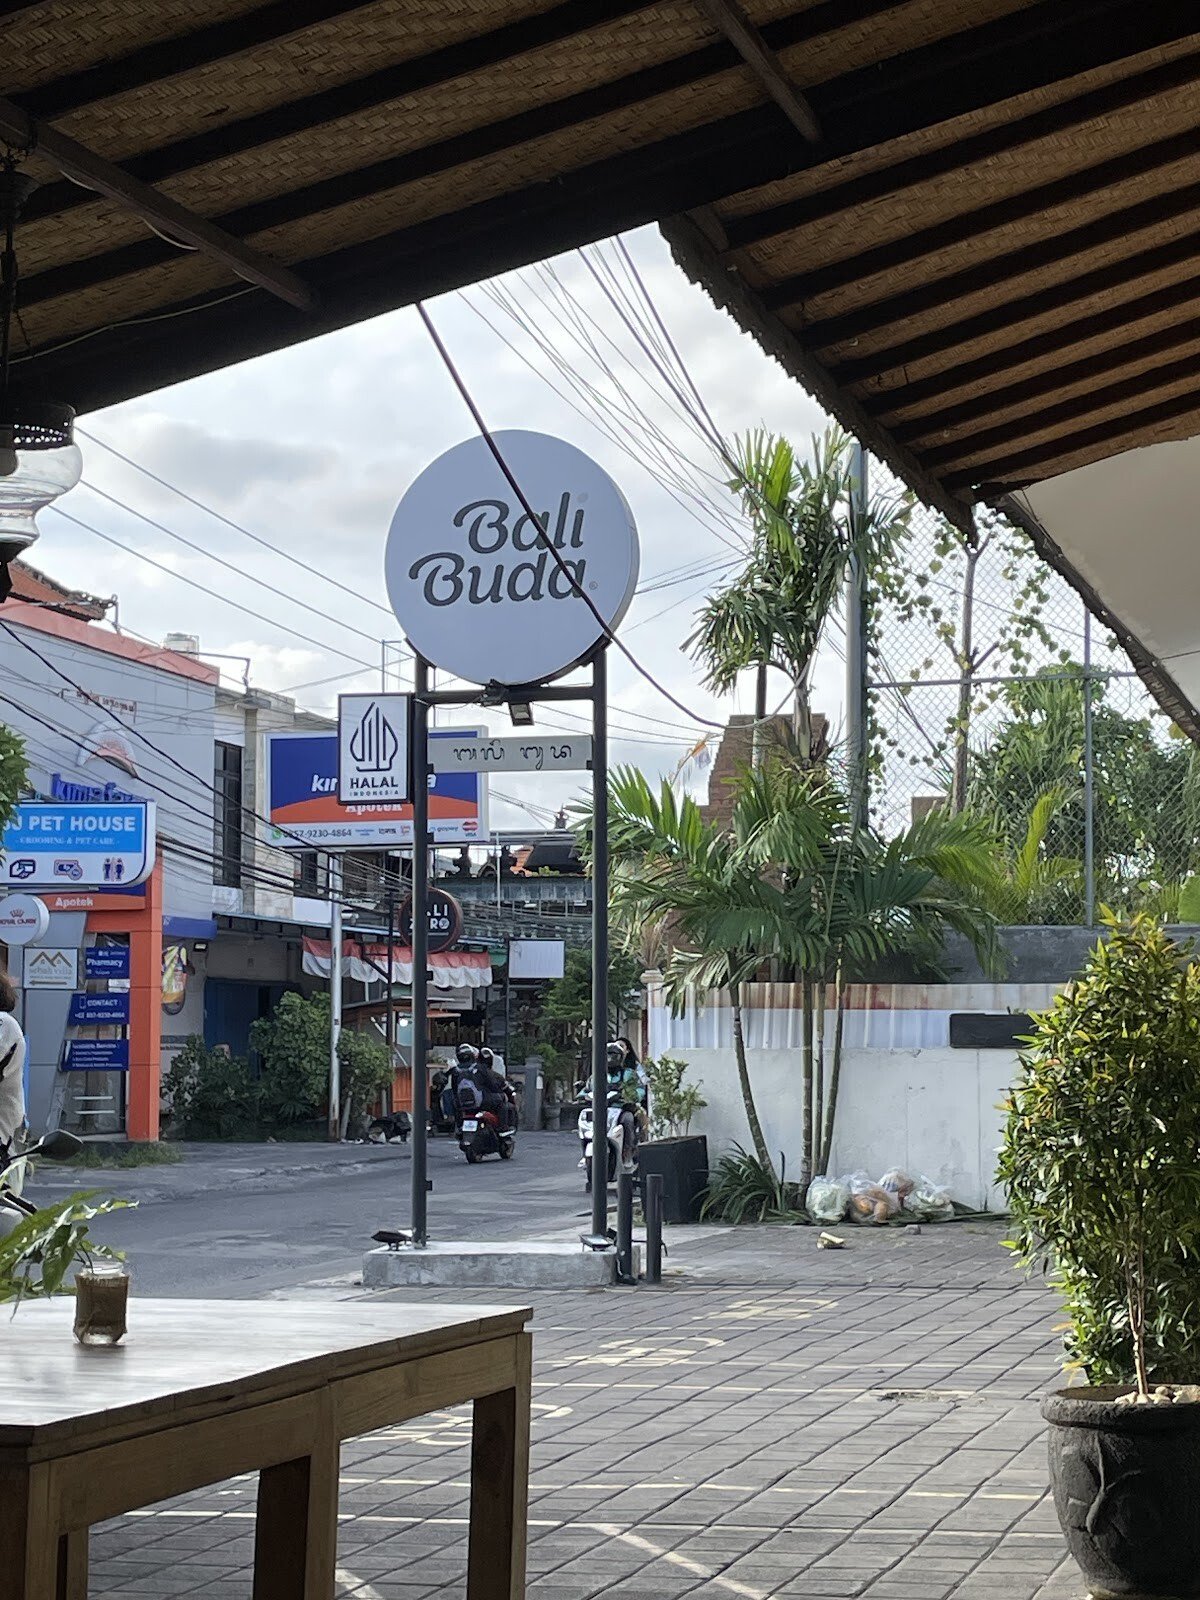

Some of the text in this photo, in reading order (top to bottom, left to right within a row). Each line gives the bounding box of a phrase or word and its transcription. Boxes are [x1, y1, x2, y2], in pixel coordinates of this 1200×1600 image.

[452, 491, 589, 554] Bali
[350, 776, 399, 789] HALAL
[29, 815, 65, 831] PET
[70, 816, 136, 832] HOUSE
[55, 897, 94, 909] Apotek
[86, 958, 124, 968] Pharmacy
